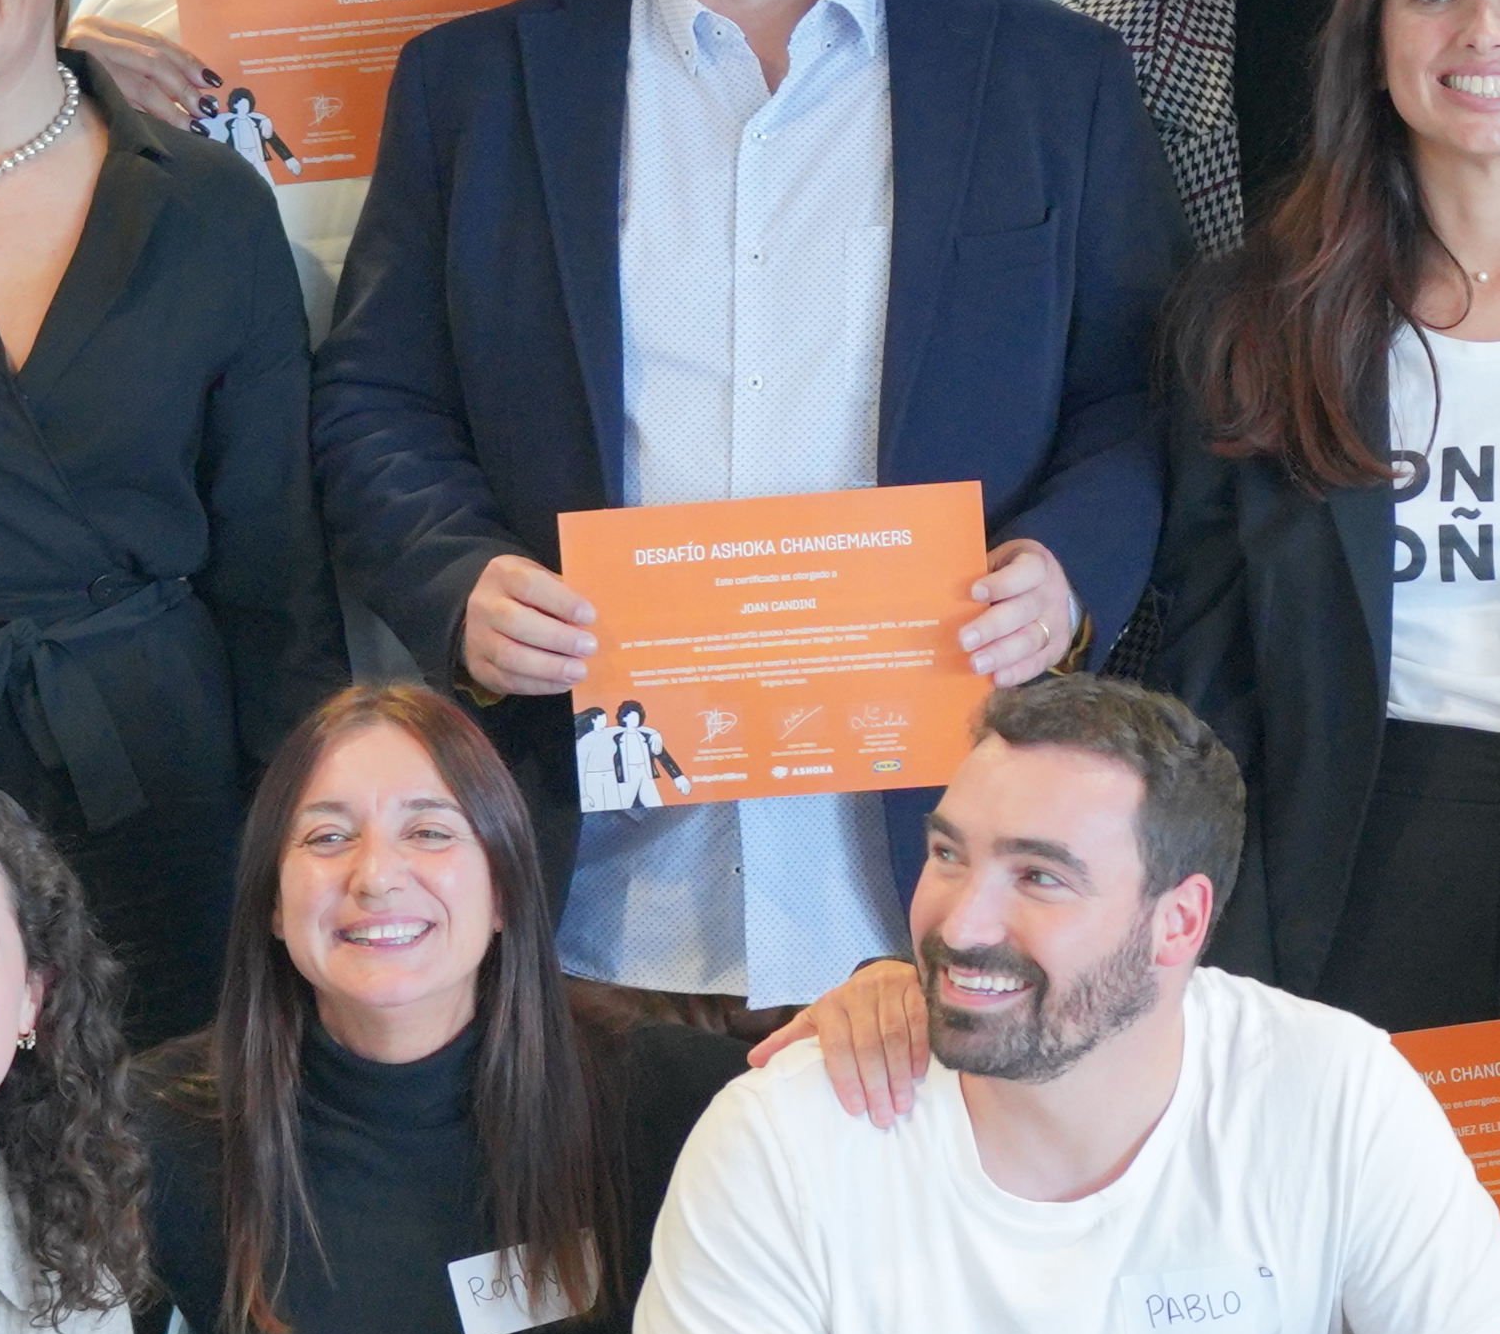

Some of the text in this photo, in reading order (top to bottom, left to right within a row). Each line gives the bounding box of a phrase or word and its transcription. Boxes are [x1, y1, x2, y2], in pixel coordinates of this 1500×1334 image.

[634, 529, 913, 566] DESAFÍO ASHOKA CHANGEMAKERS
[715, 577, 735, 587] Este
[734, 574, 780, 585] certificado
[792, 570, 831, 582] otorgado
[792, 764, 833, 775] ASHOKA
[1145, 1290, 1242, 1329] PABLO
